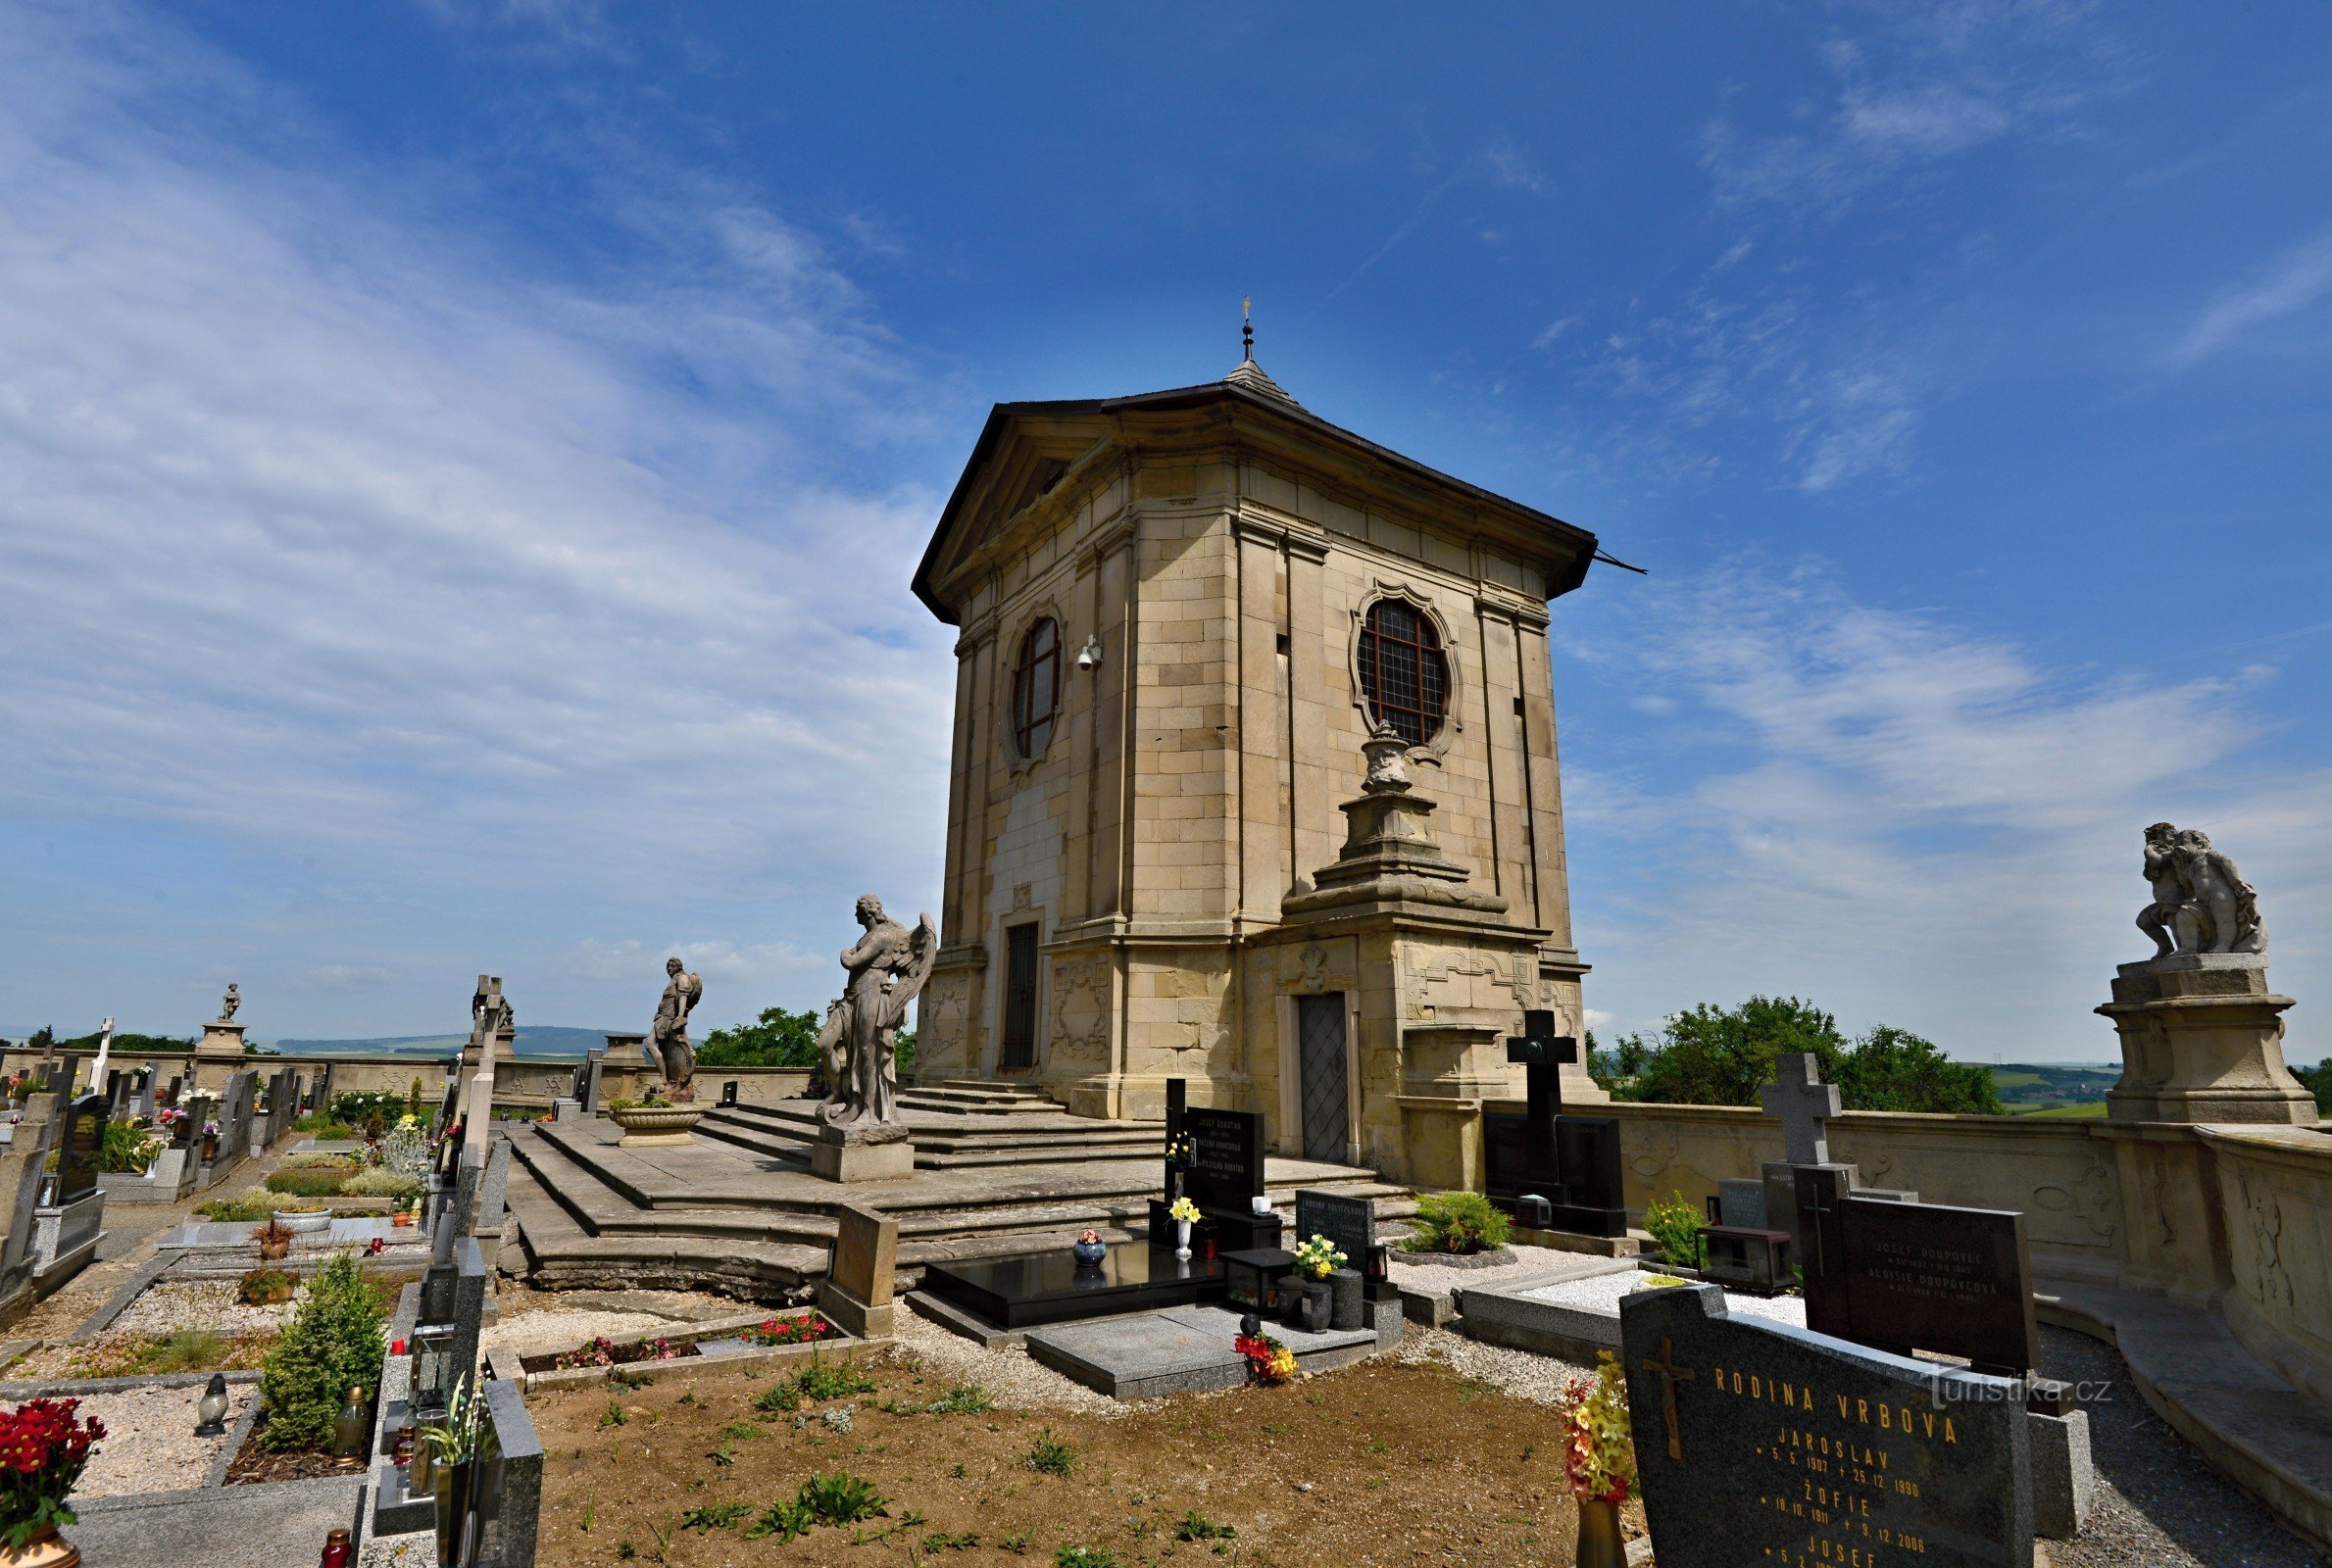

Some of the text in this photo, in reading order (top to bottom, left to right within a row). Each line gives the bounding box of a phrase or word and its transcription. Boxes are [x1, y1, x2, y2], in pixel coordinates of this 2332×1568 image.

[1877, 1242, 1983, 1264] JOSEF DOUPOVEC
[1869, 1268, 1913, 1284] ALOISIE
[1715, 1368, 1957, 1444] RODINA VRBOVA
[1778, 1427, 1888, 1469] JAROSLAV
[1807, 1456, 1828, 1474] 1907
[1853, 1468, 1870, 1485] 25.
[1894, 1479, 1919, 1498] 1990
[1805, 1478, 1870, 1517] ŽOFIE
[1776, 1498, 1789, 1513] 18.
[1793, 1502, 1806, 1518] 10.
[1811, 1508, 1829, 1525] 1911
[1898, 1533, 1925, 1553] 2006
[1809, 1536, 1875, 1568] JOSEF
